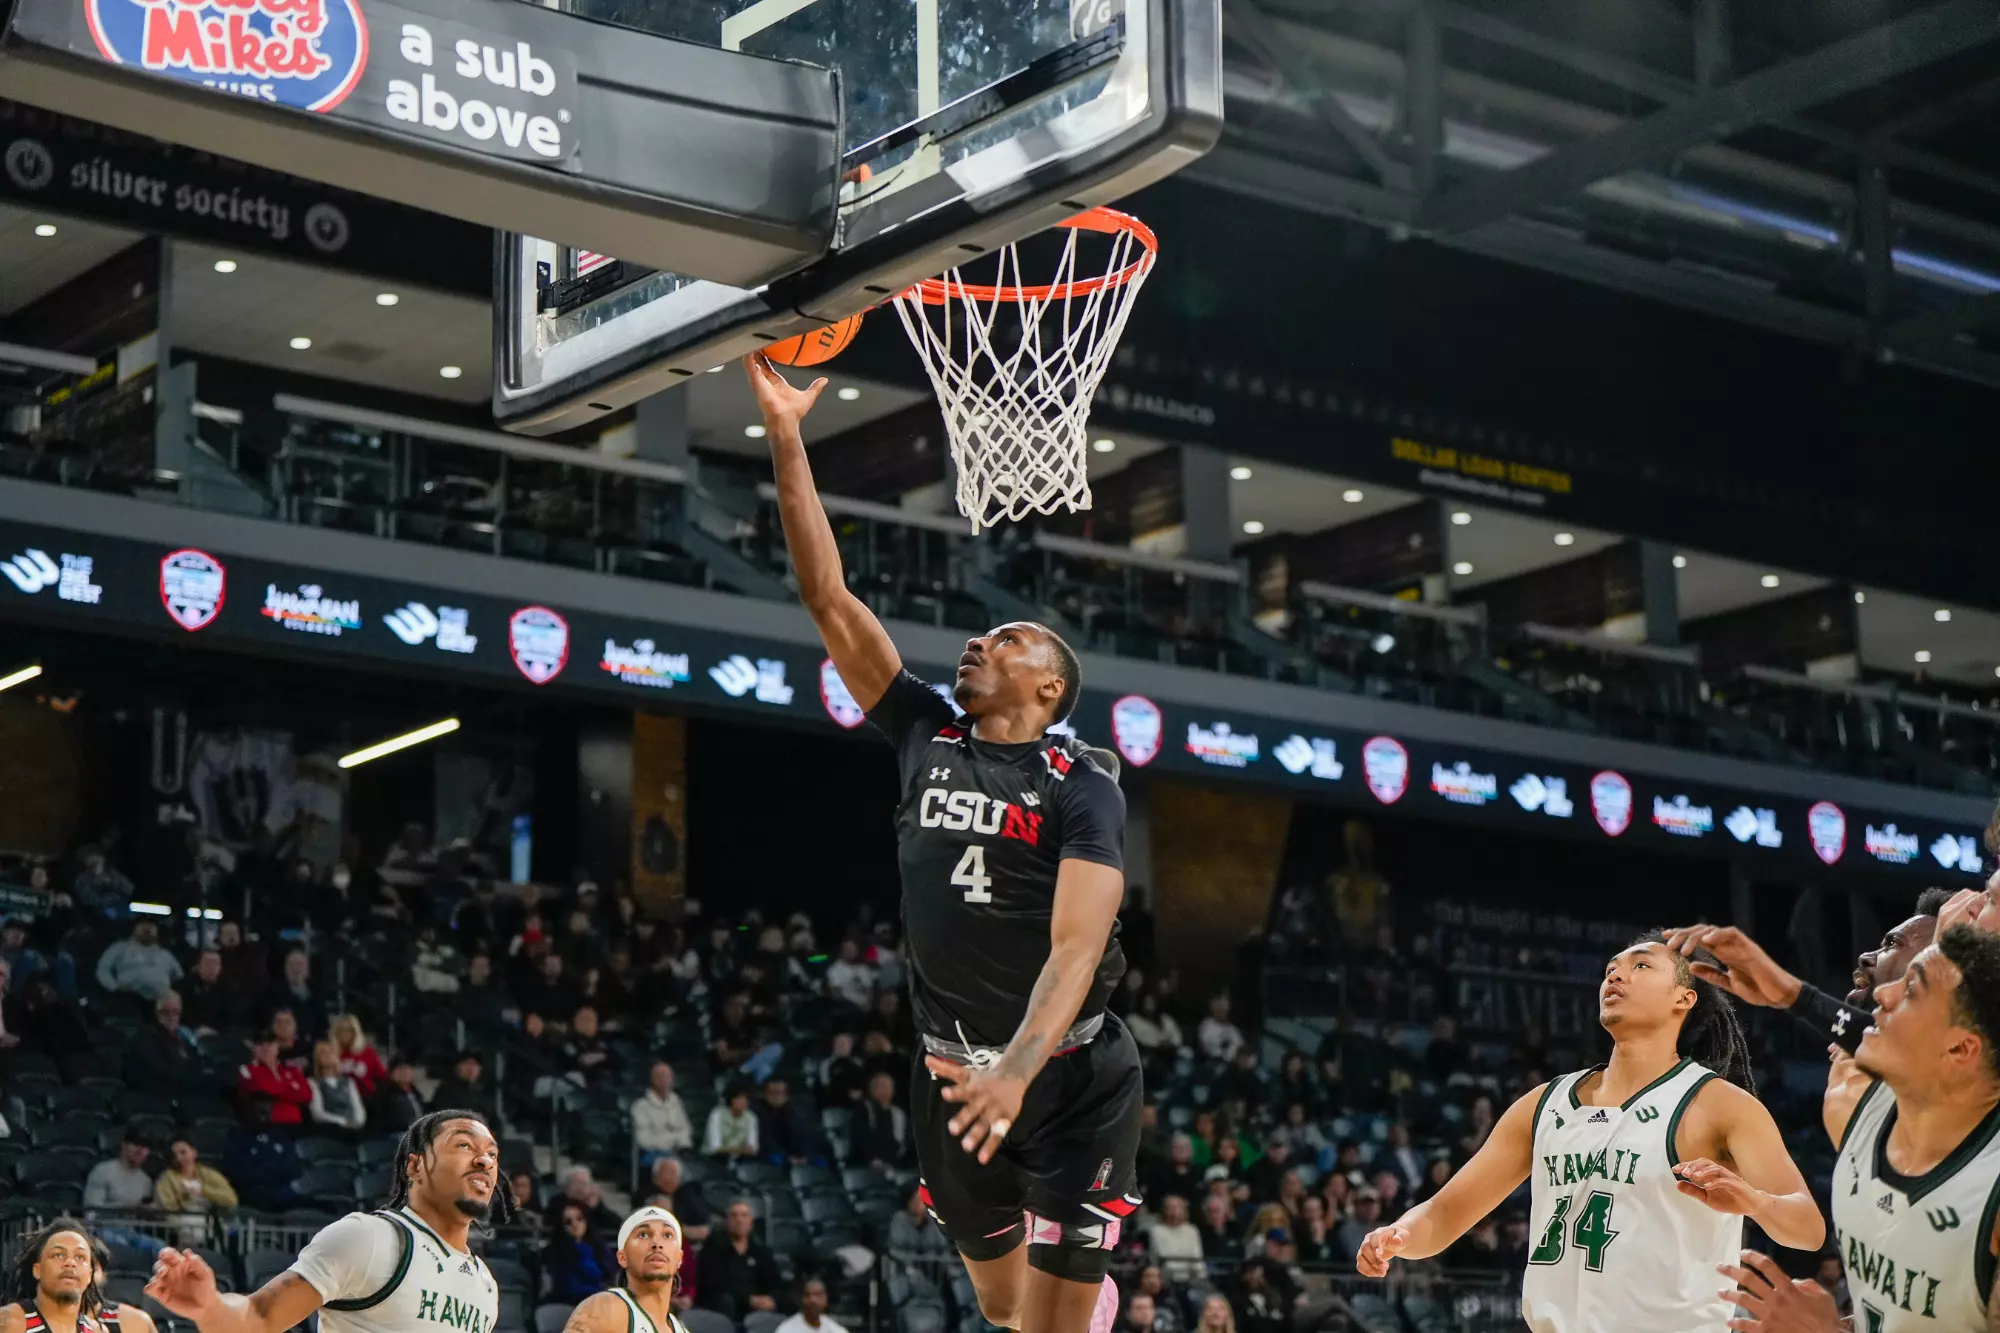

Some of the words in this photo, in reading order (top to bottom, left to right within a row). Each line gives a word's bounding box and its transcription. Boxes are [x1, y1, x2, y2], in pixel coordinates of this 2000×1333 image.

[143, 6, 329, 78] Mike's
[400, 24, 434, 66] a
[455, 36, 557, 96] sub
[71, 157, 168, 208] silver
[174, 186, 290, 241] society
[919, 787, 1043, 847] CSUN
[950, 844, 993, 904] 4
[1837, 1228, 1942, 1320] AWAI'I
